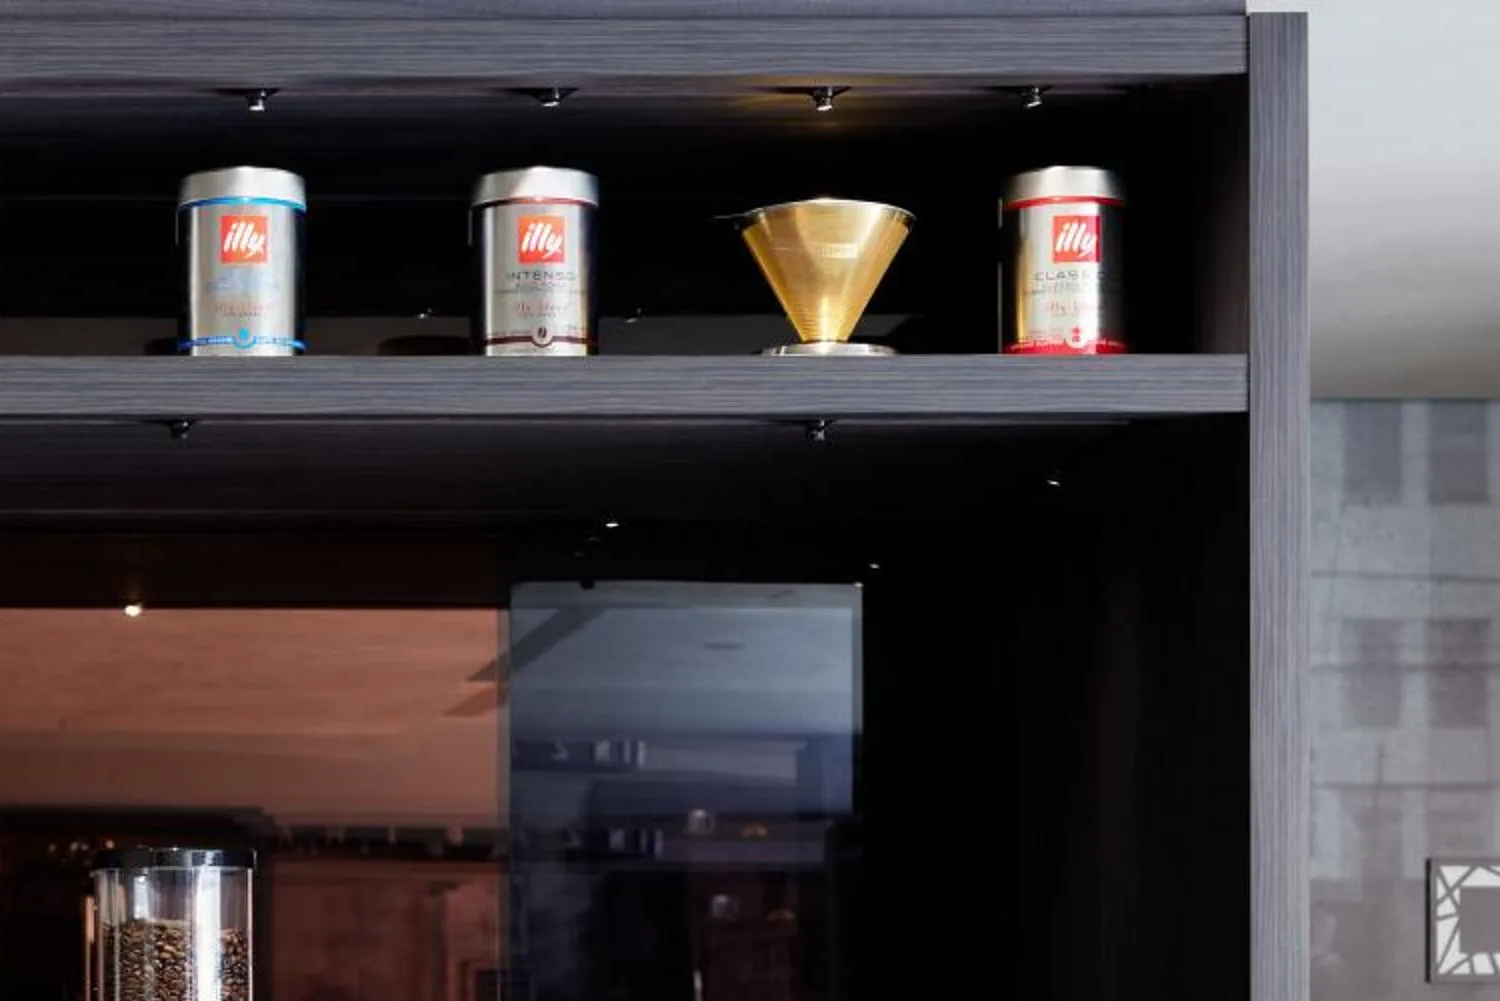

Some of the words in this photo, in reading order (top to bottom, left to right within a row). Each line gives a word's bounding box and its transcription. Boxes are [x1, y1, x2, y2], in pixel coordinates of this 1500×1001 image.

[224, 221, 266, 259] illy
[522, 222, 563, 260] illy
[1056, 222, 1098, 259] illy
